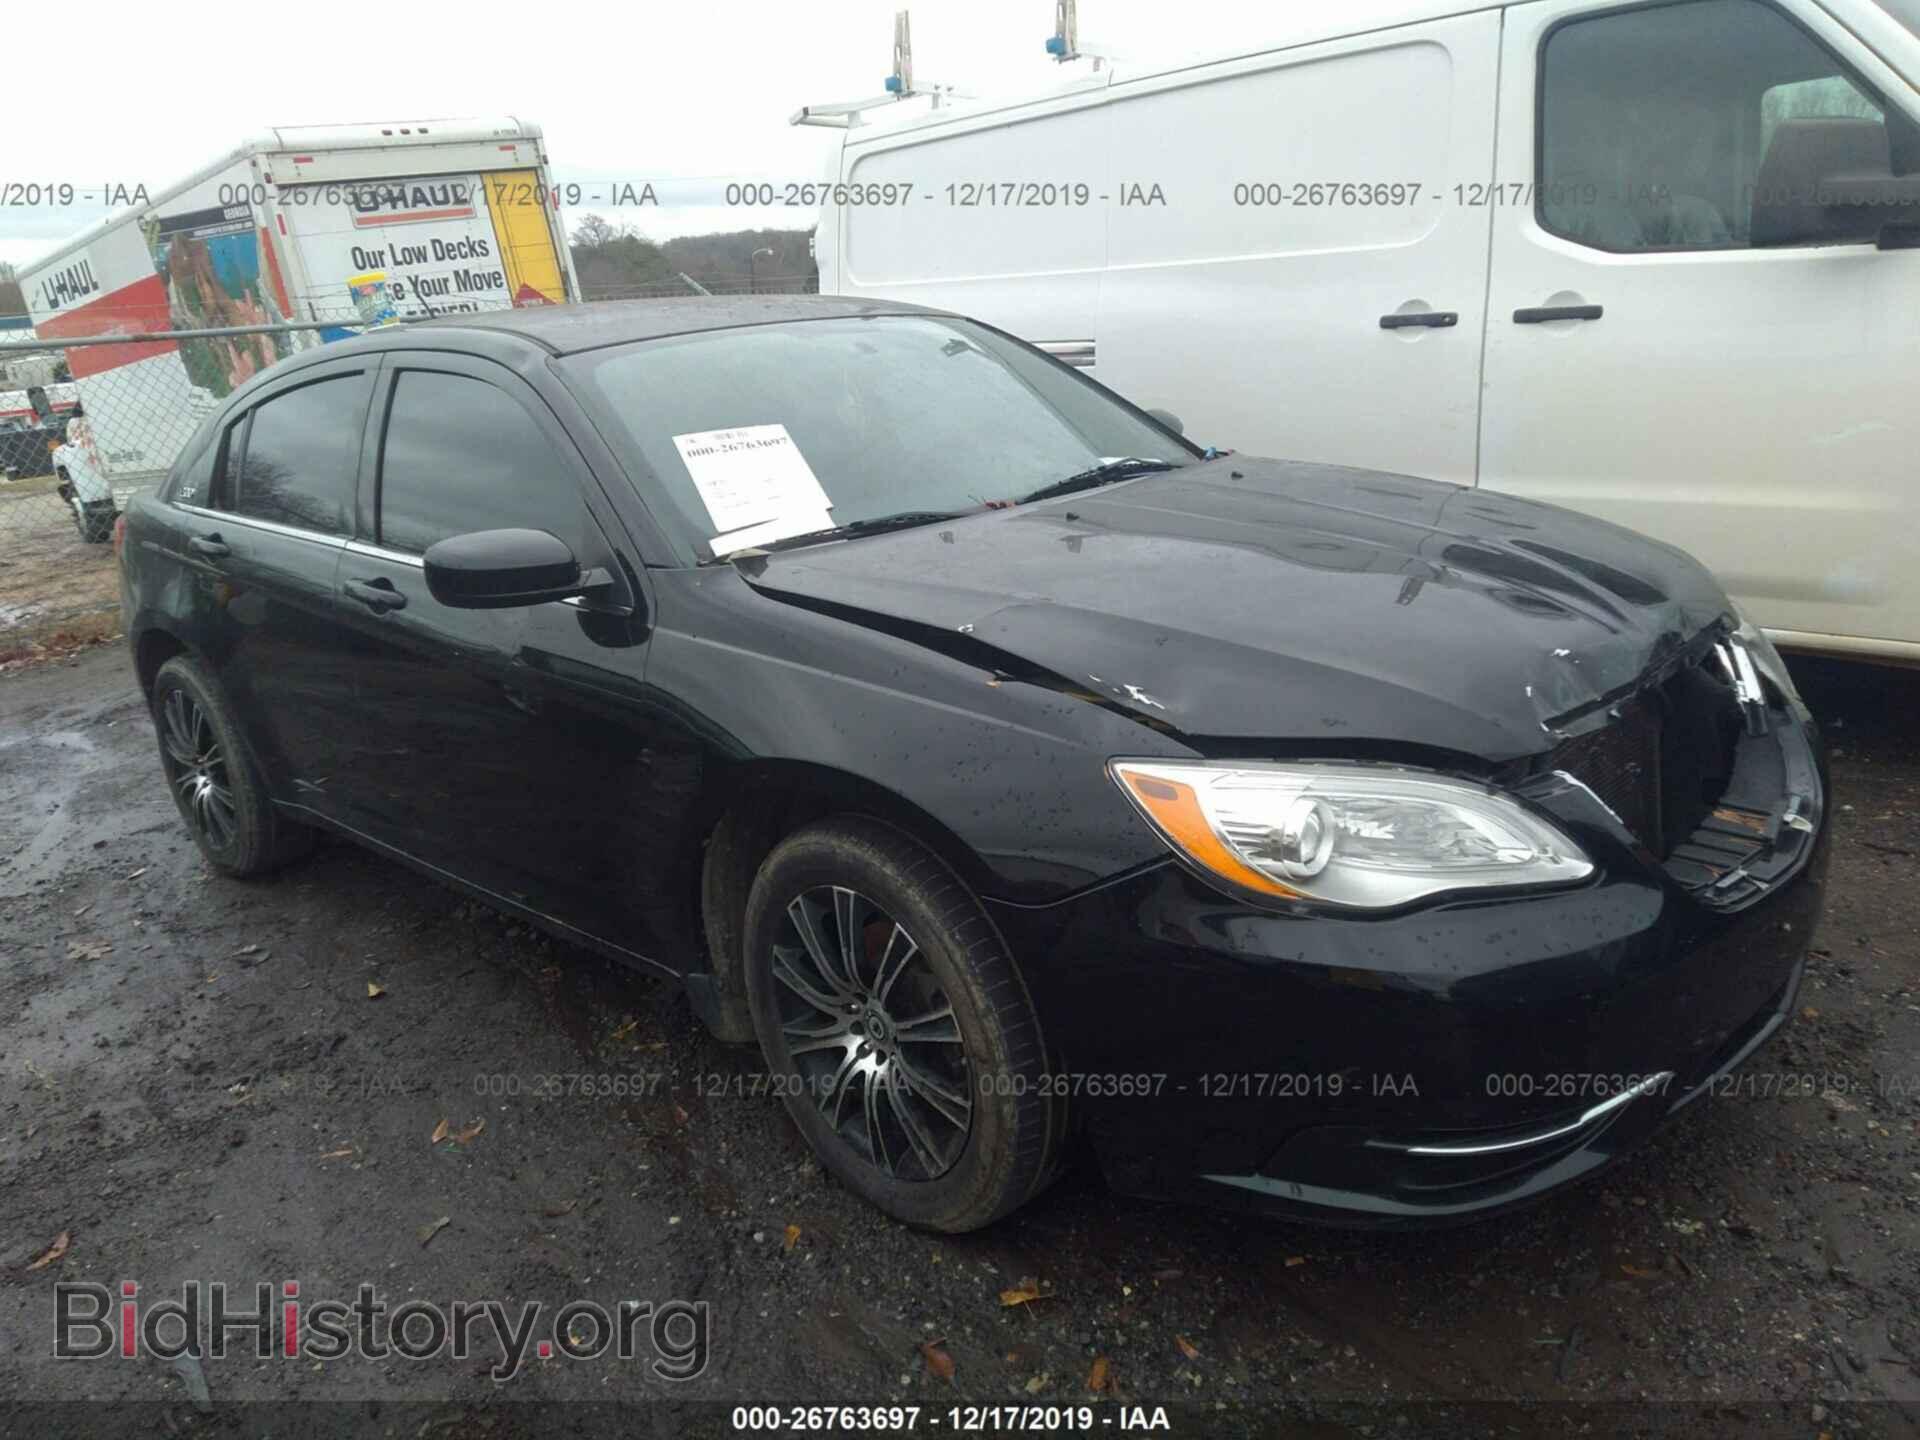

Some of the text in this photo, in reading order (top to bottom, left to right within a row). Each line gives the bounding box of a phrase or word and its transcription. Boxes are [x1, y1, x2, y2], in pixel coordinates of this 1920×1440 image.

[351, 235, 490, 271] Our Low Decks
[406, 273, 450, 299] Your
[453, 268, 504, 294] Move
